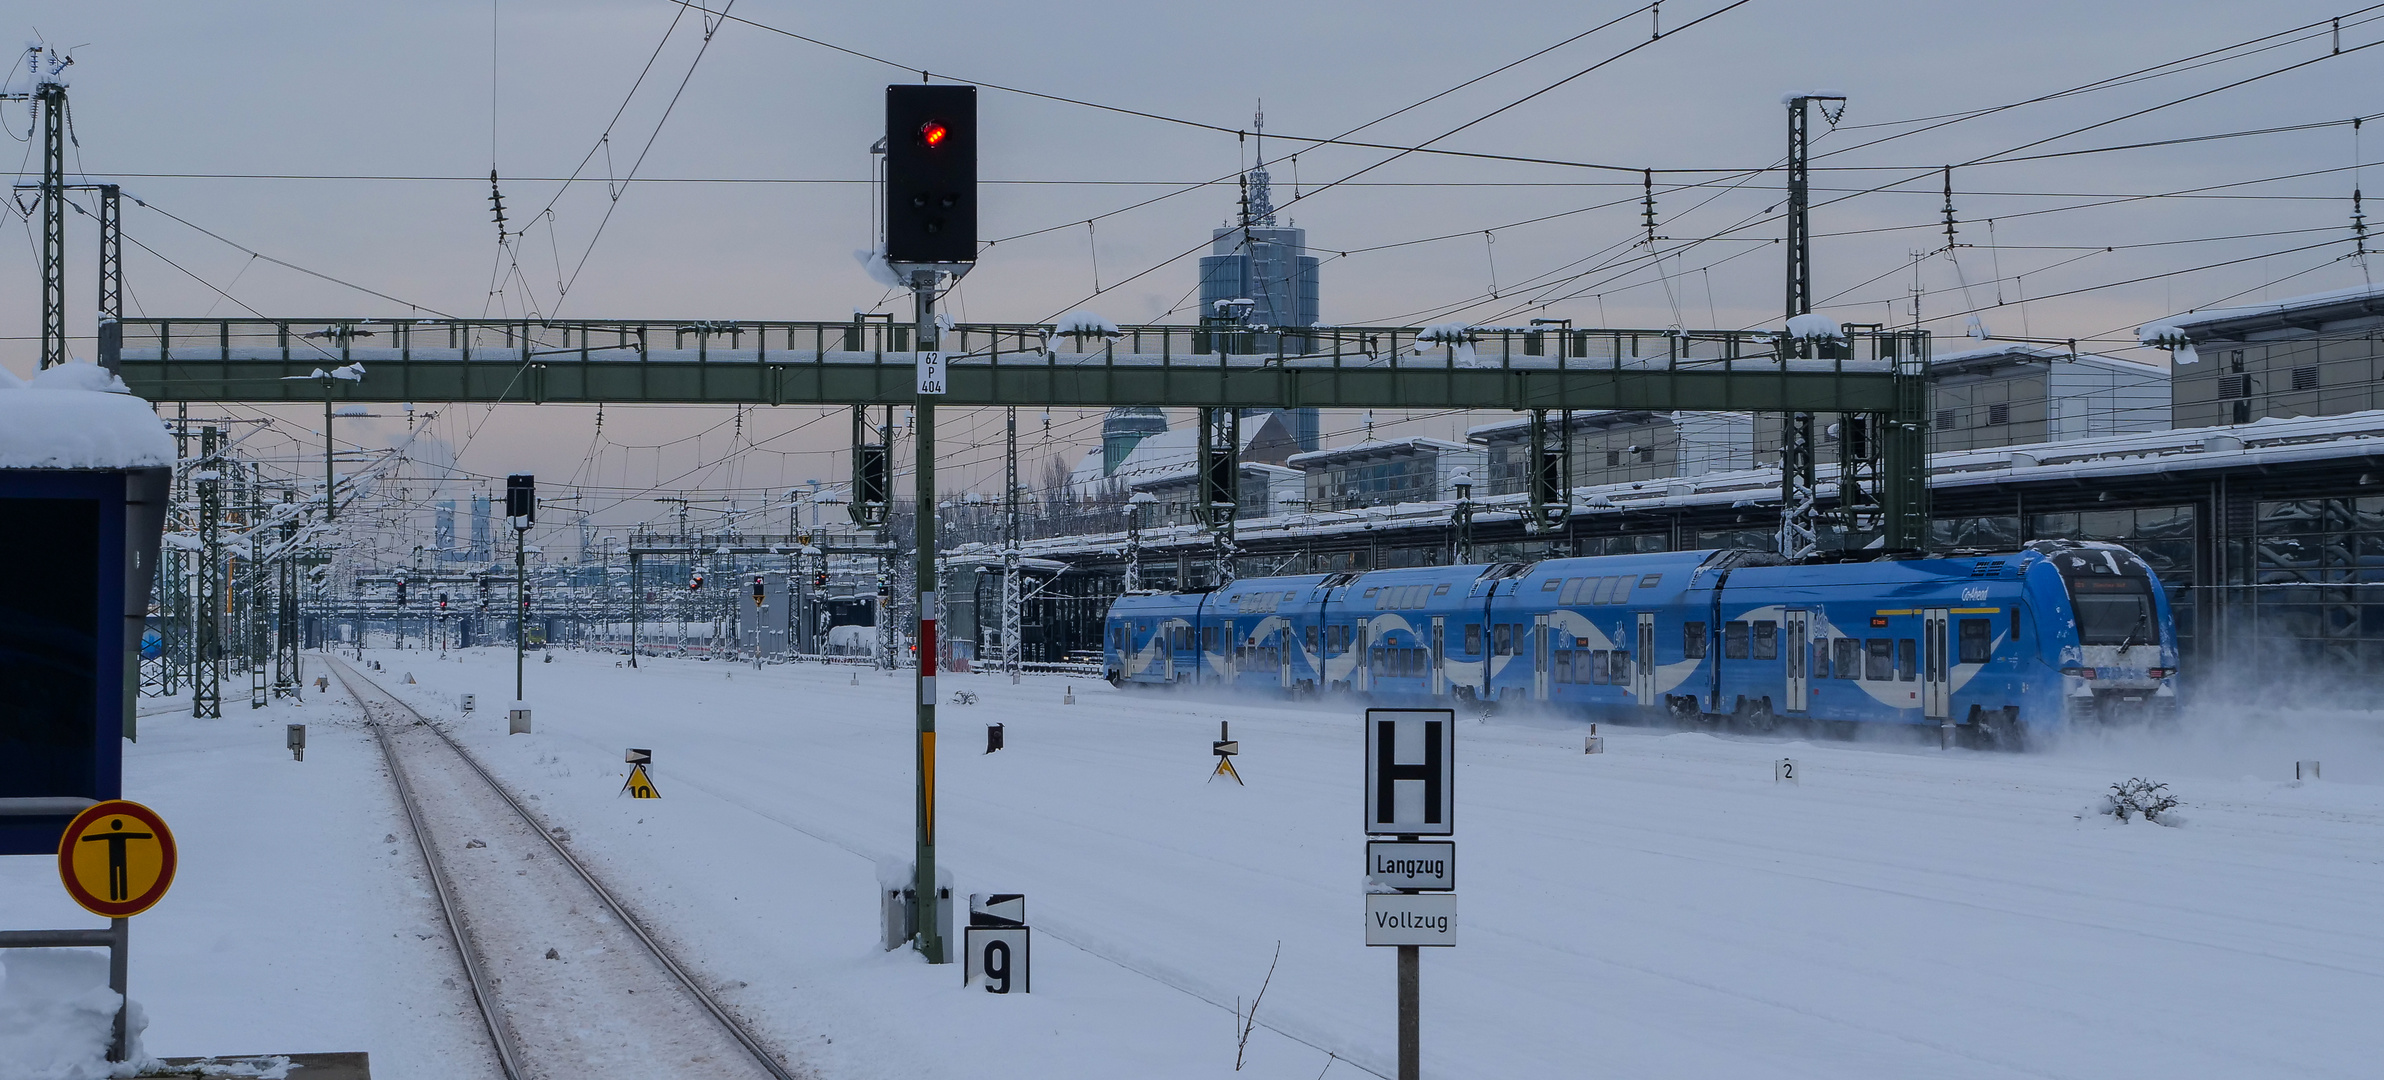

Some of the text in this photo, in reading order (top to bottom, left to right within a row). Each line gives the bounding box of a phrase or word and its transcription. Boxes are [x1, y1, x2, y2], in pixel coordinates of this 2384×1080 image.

[926, 353, 938, 365] 62
[928, 366, 935, 379] P
[921, 381, 942, 393] 404
[1377, 720, 1443, 824] H
[1783, 763, 1793, 779] 2
[1377, 854, 1445, 879] Langzug
[1375, 911, 1449, 933] Vollzug
[983, 939, 1011, 995] 9
